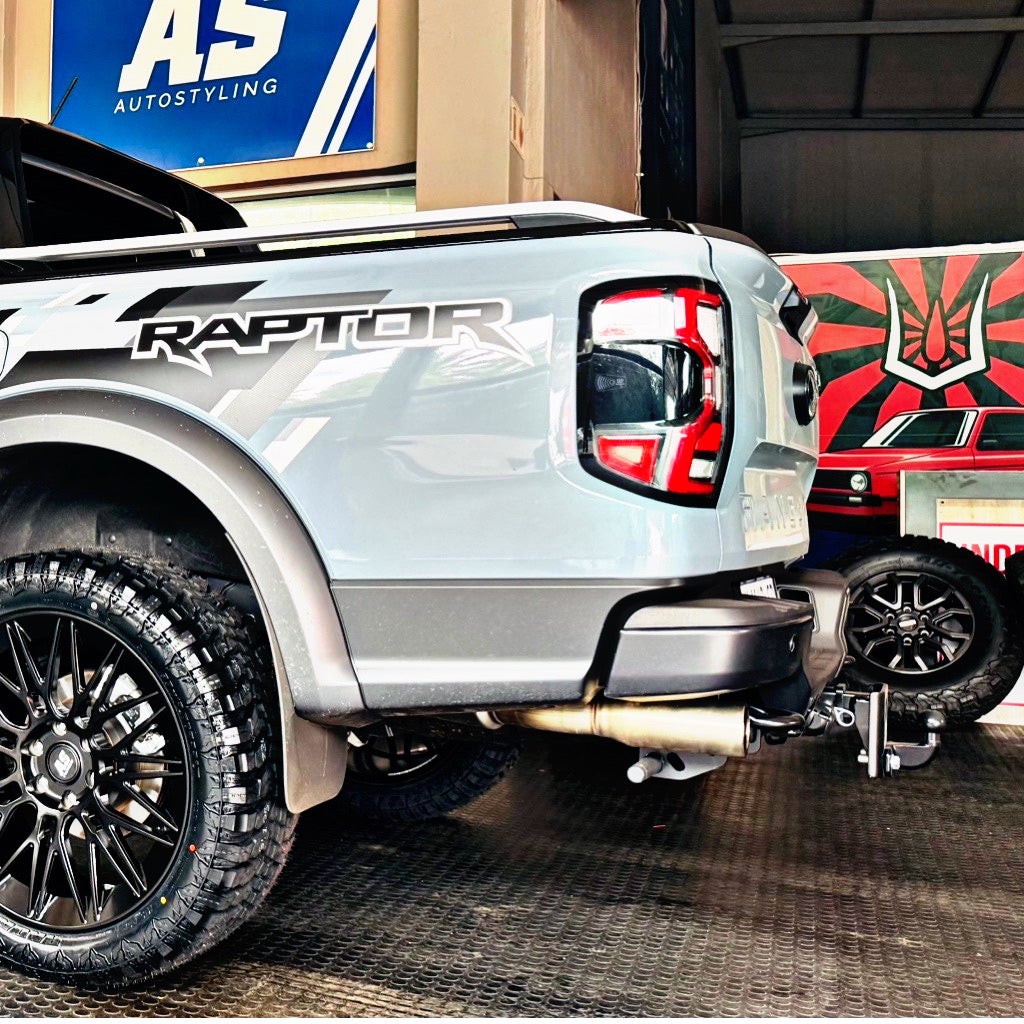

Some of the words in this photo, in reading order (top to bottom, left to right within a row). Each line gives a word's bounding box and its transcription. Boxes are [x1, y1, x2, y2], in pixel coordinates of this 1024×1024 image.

[117, 0, 288, 93] AS
[113, 78, 278, 114] AUTOSTYLING
[131, 298, 534, 376] RAPTOR
